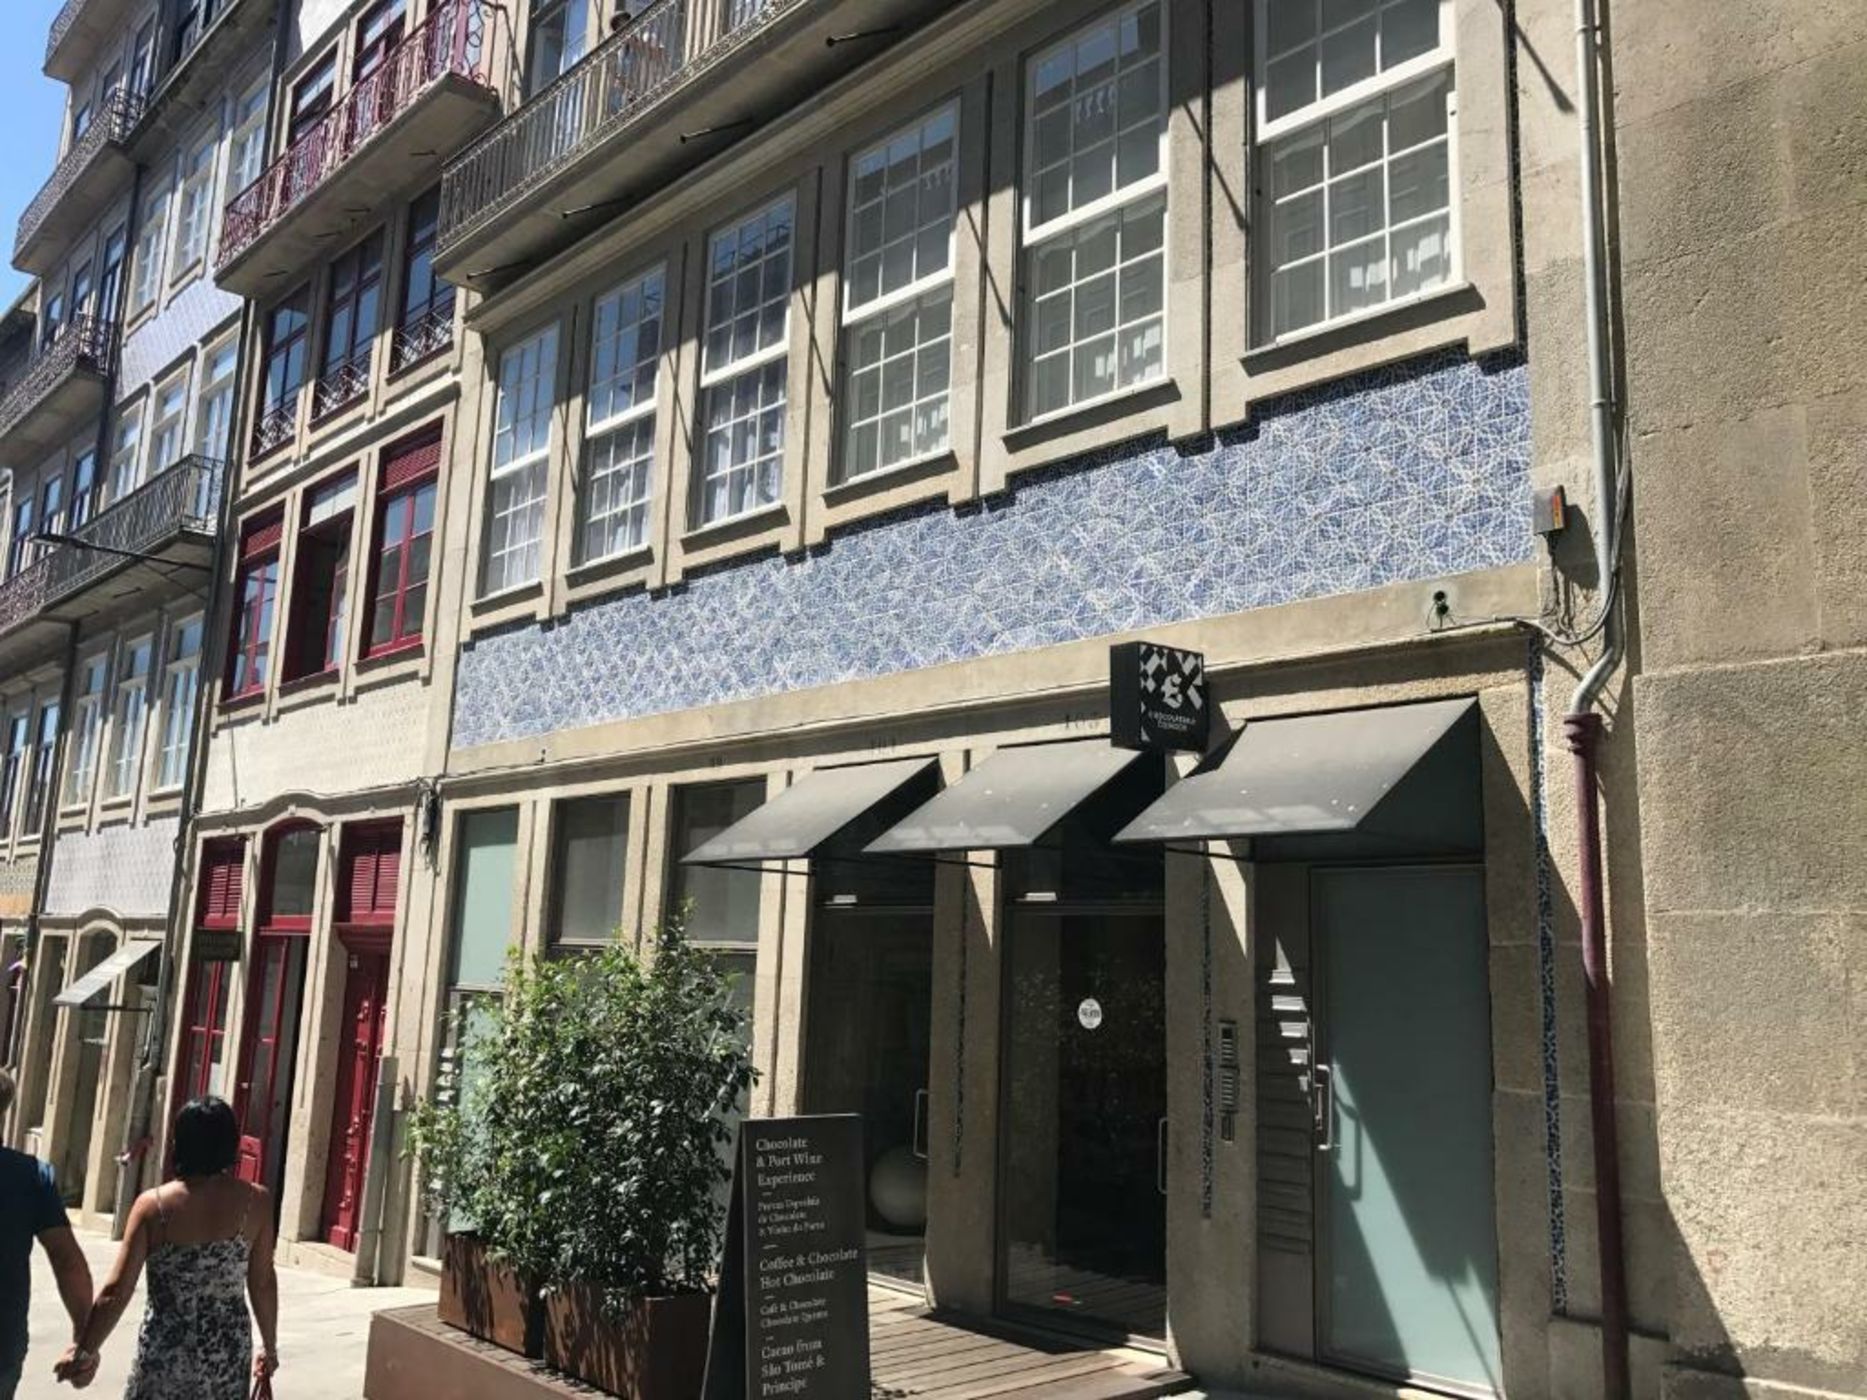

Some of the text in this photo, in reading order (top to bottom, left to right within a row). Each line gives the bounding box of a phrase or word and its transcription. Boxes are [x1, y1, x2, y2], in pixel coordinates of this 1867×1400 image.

[755, 1136, 808, 1152] Chocolate
[756, 1151, 824, 1168] & Port Wine
[757, 1171, 817, 1190] Experience
[759, 1248, 859, 1272] Coffee & Chocolate
[760, 1268, 835, 1290] Hot Chocolate
[761, 1338, 823, 1360] Cacao from
[782, 1354, 814, 1373] Tomé
[816, 1353, 826, 1368] &
